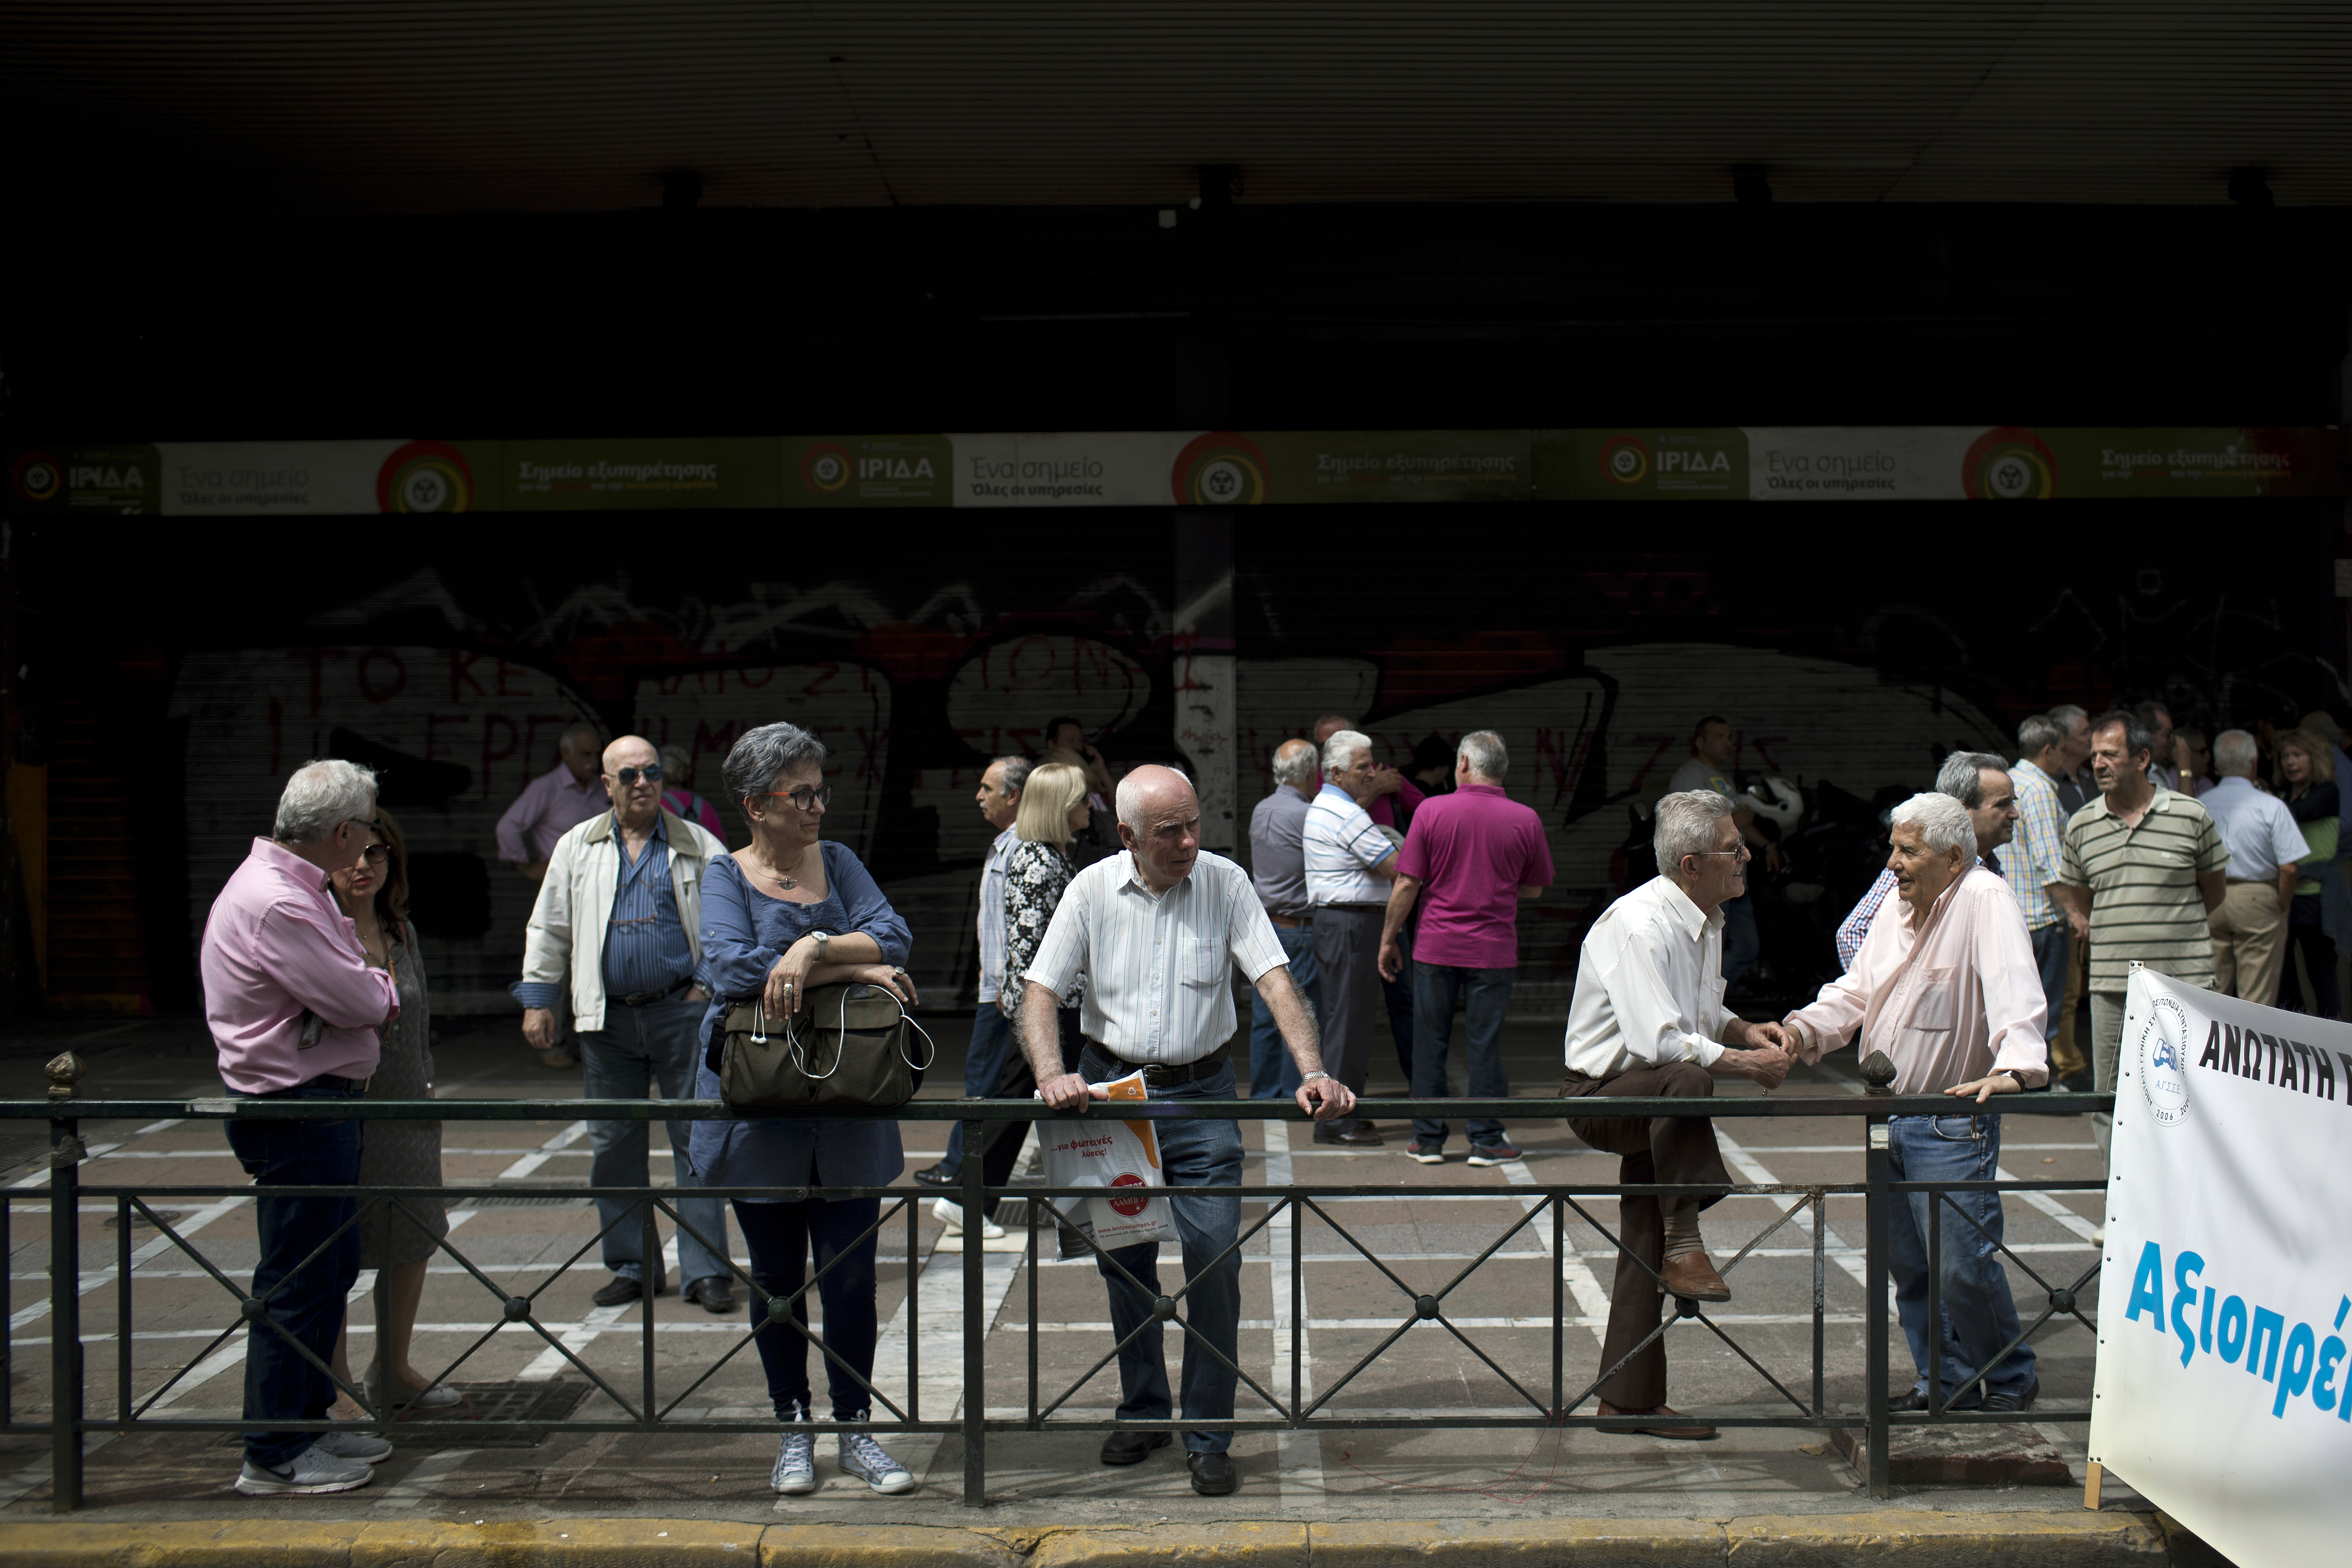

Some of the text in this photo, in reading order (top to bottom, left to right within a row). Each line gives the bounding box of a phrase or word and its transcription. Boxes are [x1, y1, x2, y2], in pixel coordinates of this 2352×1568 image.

[859, 457, 935, 479] ΙΡΙΔΑ
[970, 455, 1104, 483] Ένα σημείο
[1317, 453, 1516, 474] Σημείο εξυπηρέτησης
[1656, 450, 1731, 472] ΙΡΙΔΑ
[1765, 450, 1897, 476] Ένα σημείο
[2101, 448, 2163, 469] Σημείο
[229, 462, 309, 493] σημείο
[518, 460, 718, 482] Σημείο εξυπηρέτησης
[971, 483, 1103, 498] Όλες οι υπηρεσίες
[1767, 475, 1896, 491] Όλες οι υπηρεσίες
[2140, 1026, 2150, 1063] ΓΕΝΙΚΗ
[2198, 1020, 2335, 1101] ΑΝΩΤΑΤΗ
[2140, 1067, 2153, 1106] ΑΝΩΤΑΤΗ
[2156, 1109, 2173, 1121] 2006
[1070, 1134, 1113, 1150] φωτεινές
[1082, 1148, 1107, 1158] λύσεις!
[1097, 1220, 1157, 1233] www.lentzoslampes.gr
[2124, 1240, 2352, 1424] Αξιοπρέ
